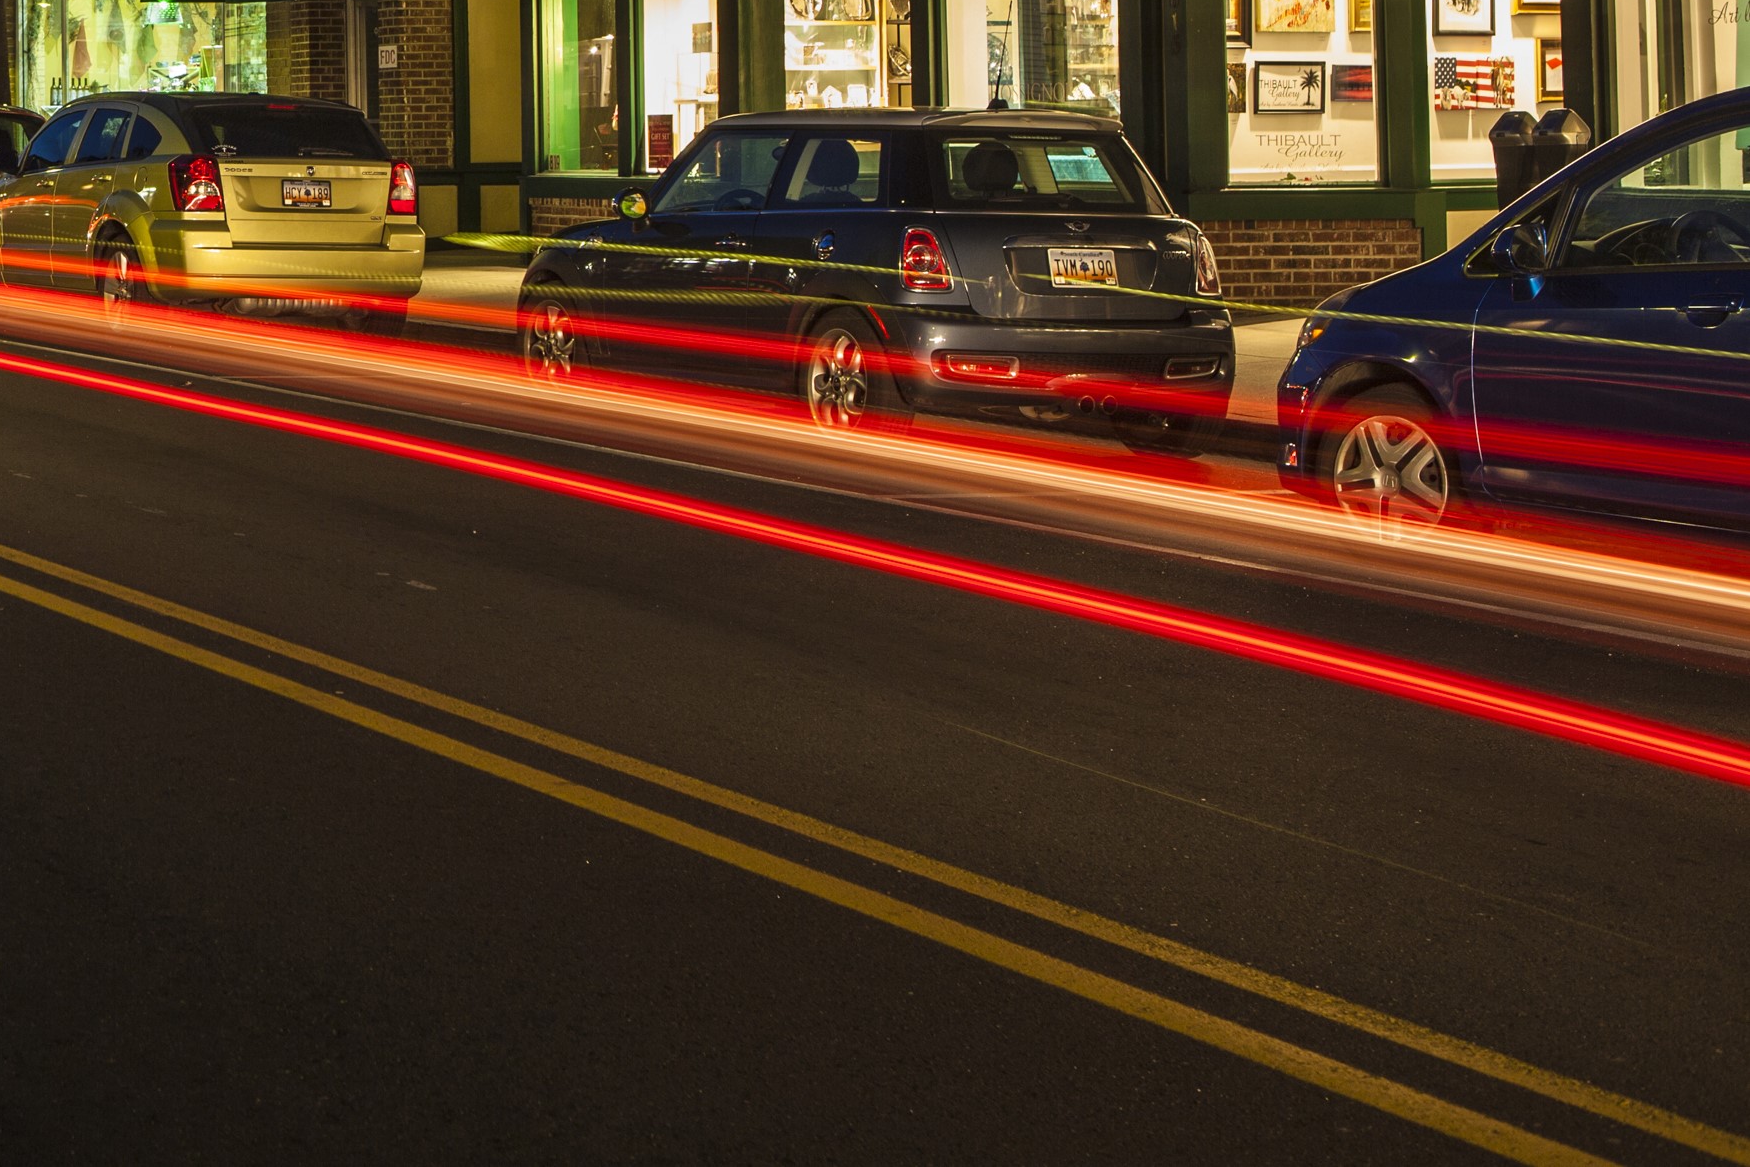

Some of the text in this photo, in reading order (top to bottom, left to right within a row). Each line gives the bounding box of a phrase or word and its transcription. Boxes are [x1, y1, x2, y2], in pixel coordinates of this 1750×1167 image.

[1708, 1, 1738, 25] Art
[380, 50, 396, 65] FDC
[1259, 79, 1297, 88] THIBAULT
[1268, 87, 1300, 101] Gallery
[1255, 134, 1341, 146] THIBAULT
[1278, 145, 1345, 162] Gallery
[285, 187, 329, 200] HCY 189
[1054, 259, 1113, 277] IVM 190
